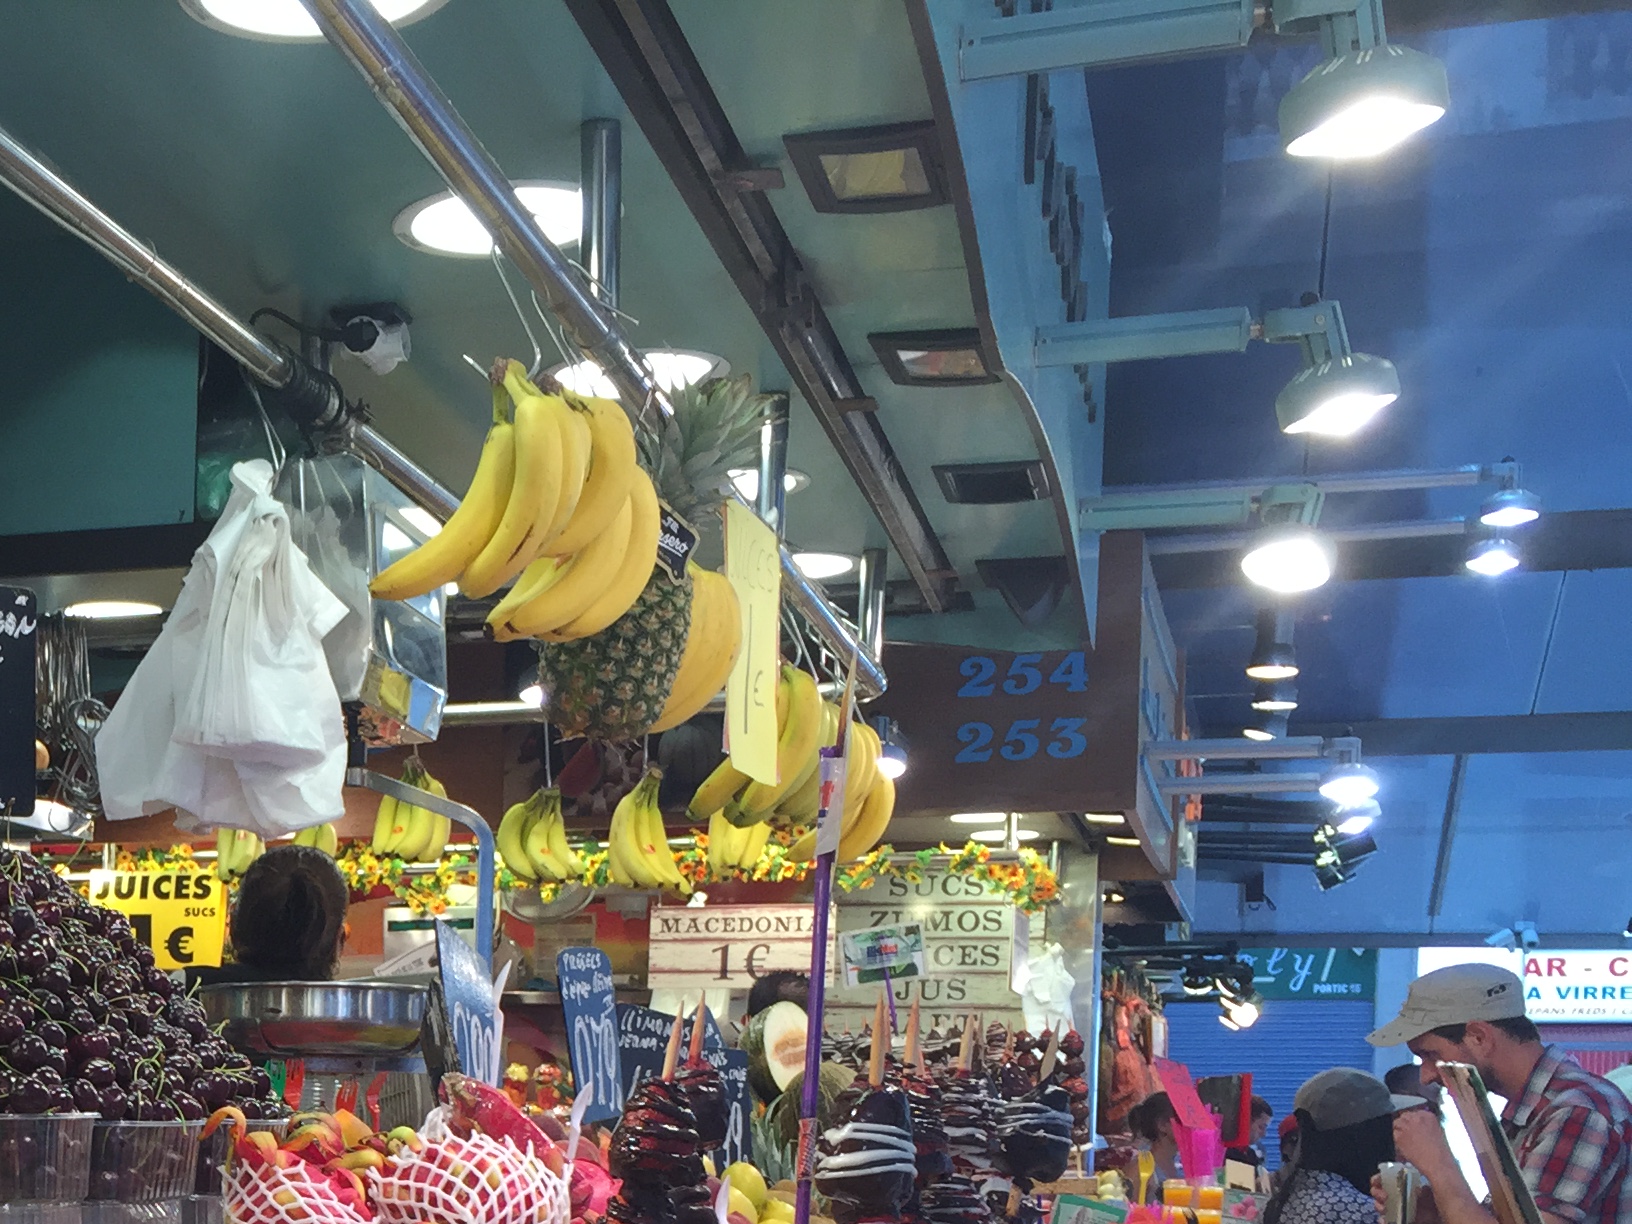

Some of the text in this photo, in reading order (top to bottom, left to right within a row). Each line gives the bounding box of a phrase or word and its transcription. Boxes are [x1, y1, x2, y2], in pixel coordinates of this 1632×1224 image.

[957, 651, 1090, 698] 254
[954, 717, 1088, 763] 253
[95, 875, 212, 900] JUICES
[889, 874, 984, 897] SUCS
[184, 907, 216, 917] SUCS
[895, 979, 967, 1001] JUS
